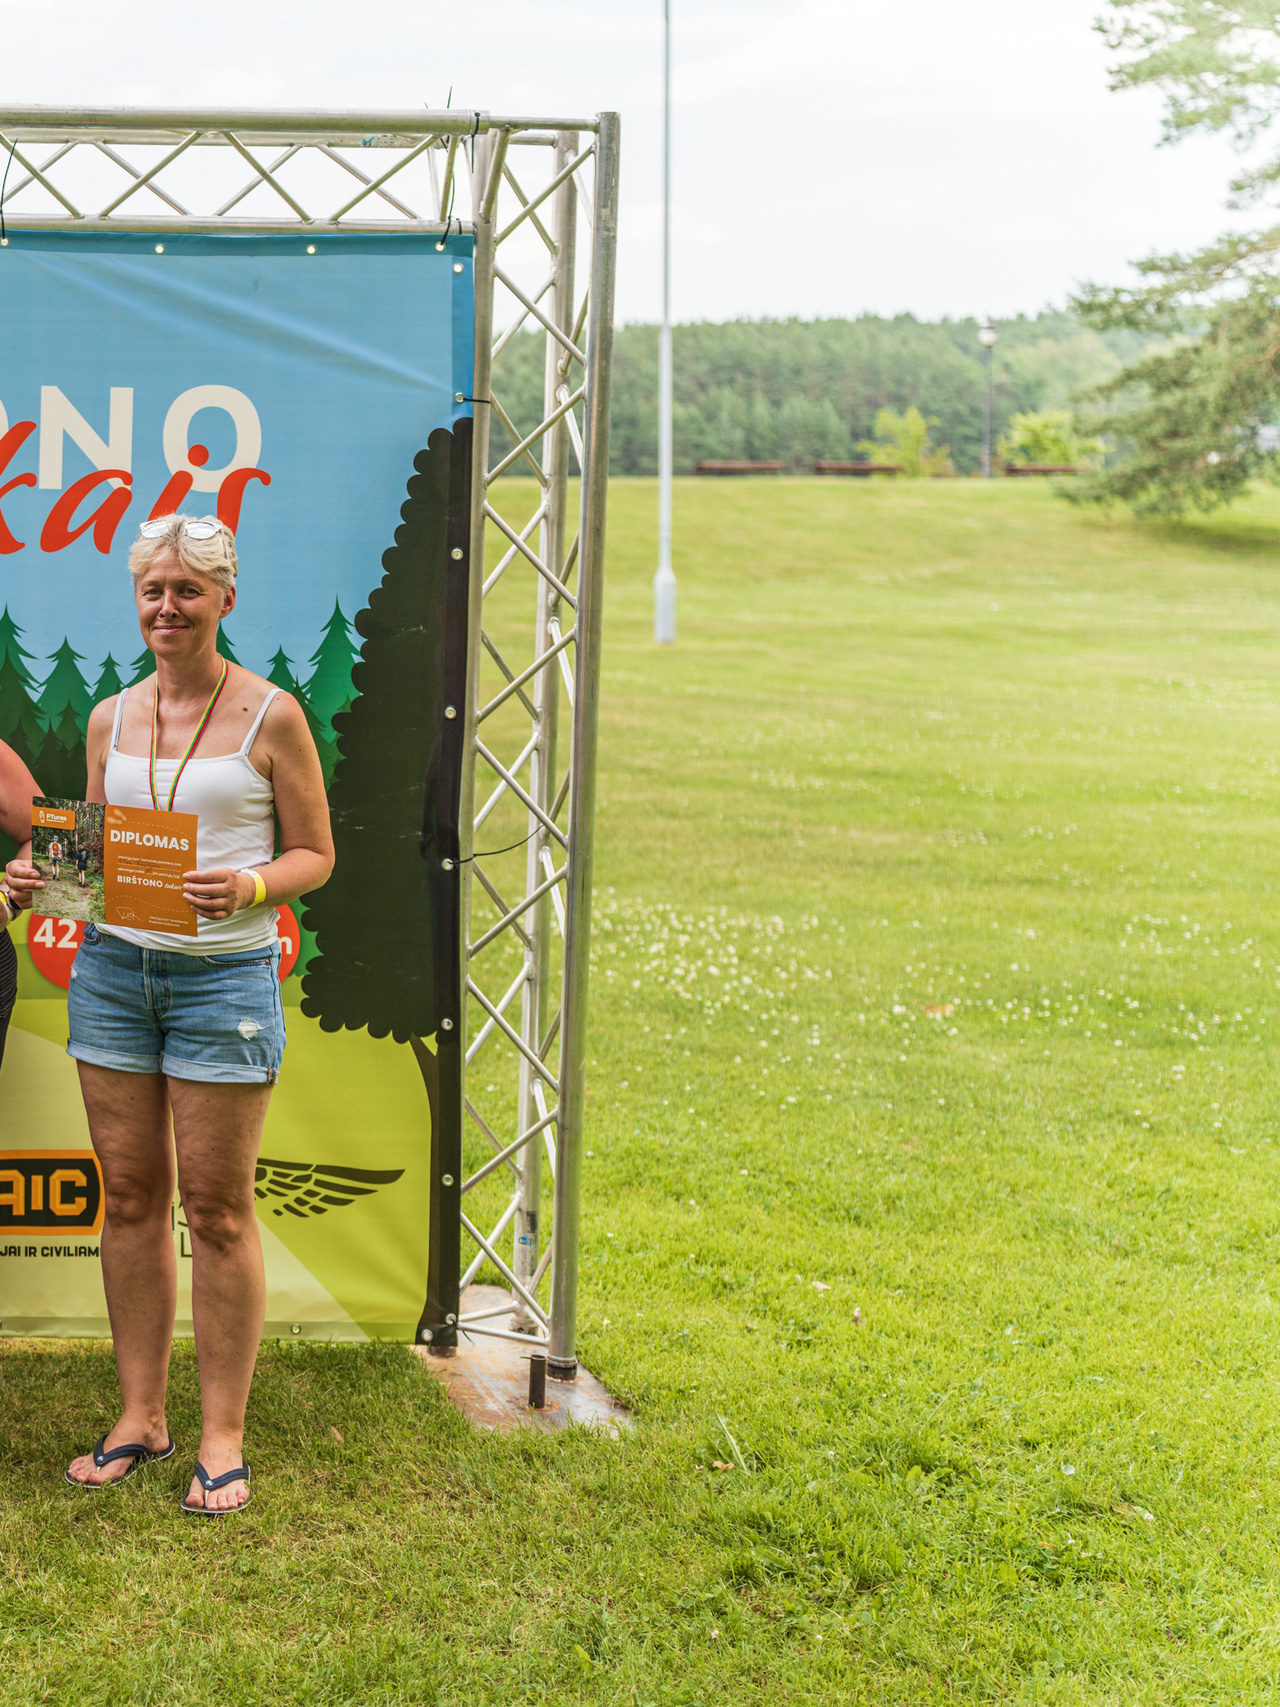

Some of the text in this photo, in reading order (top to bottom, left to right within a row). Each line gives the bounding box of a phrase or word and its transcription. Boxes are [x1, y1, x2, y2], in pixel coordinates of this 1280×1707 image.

[110, 829, 190, 851] DIPLOMAS
[117, 875, 163, 888] BIRŠTONO
[33, 918, 78, 949] 42
[24, 1246, 37, 1258] IR
[41, 1246, 101, 1258] CIVILIAM
